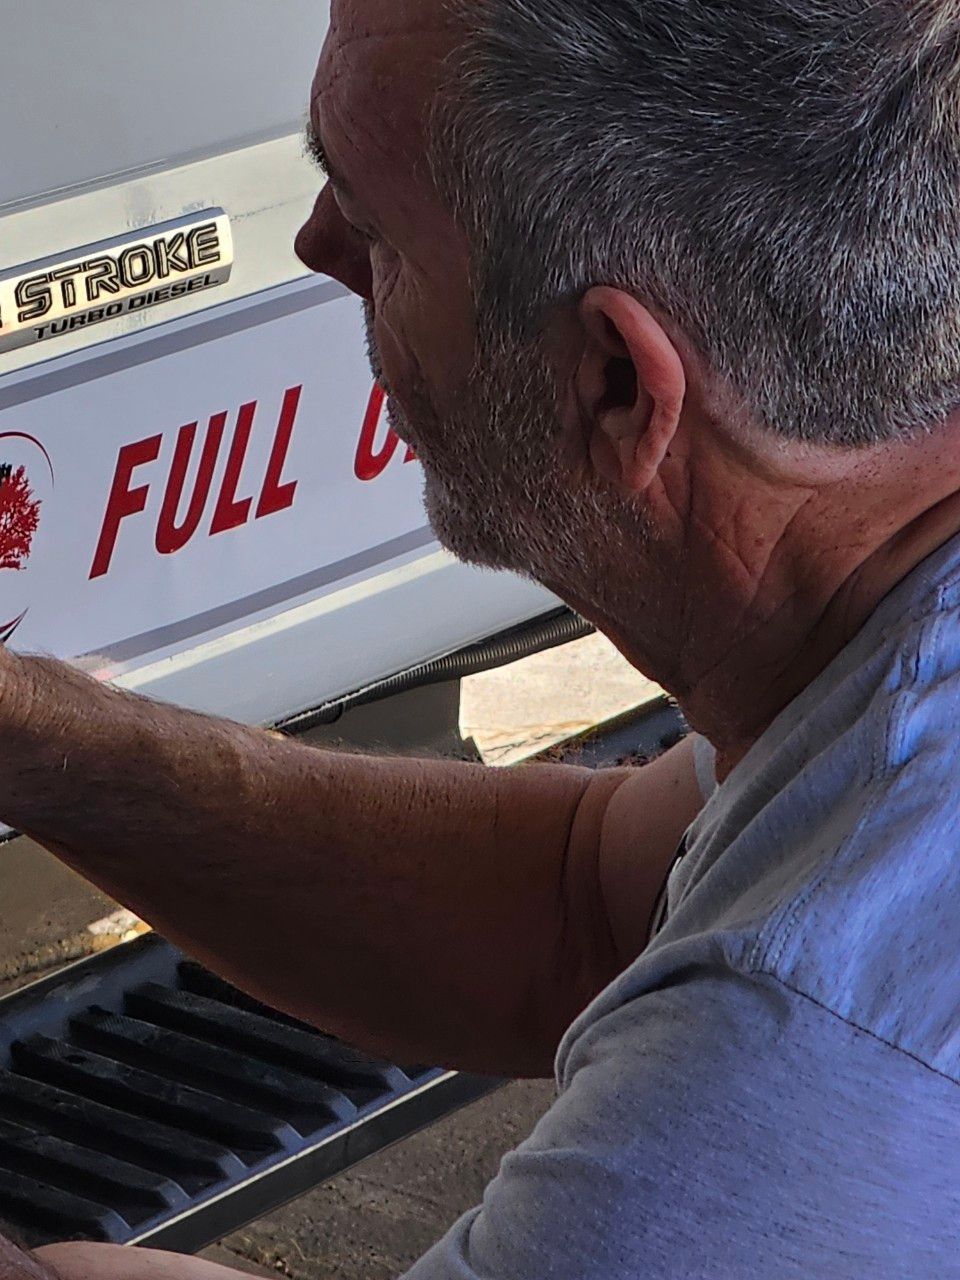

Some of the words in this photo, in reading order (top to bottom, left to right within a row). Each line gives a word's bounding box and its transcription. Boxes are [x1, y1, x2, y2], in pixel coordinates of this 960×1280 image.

[15, 221, 221, 323] STROKE
[34, 302, 123, 340] TURBO
[127, 273, 220, 311] DIESEL
[87, 384, 304, 581] FULL
